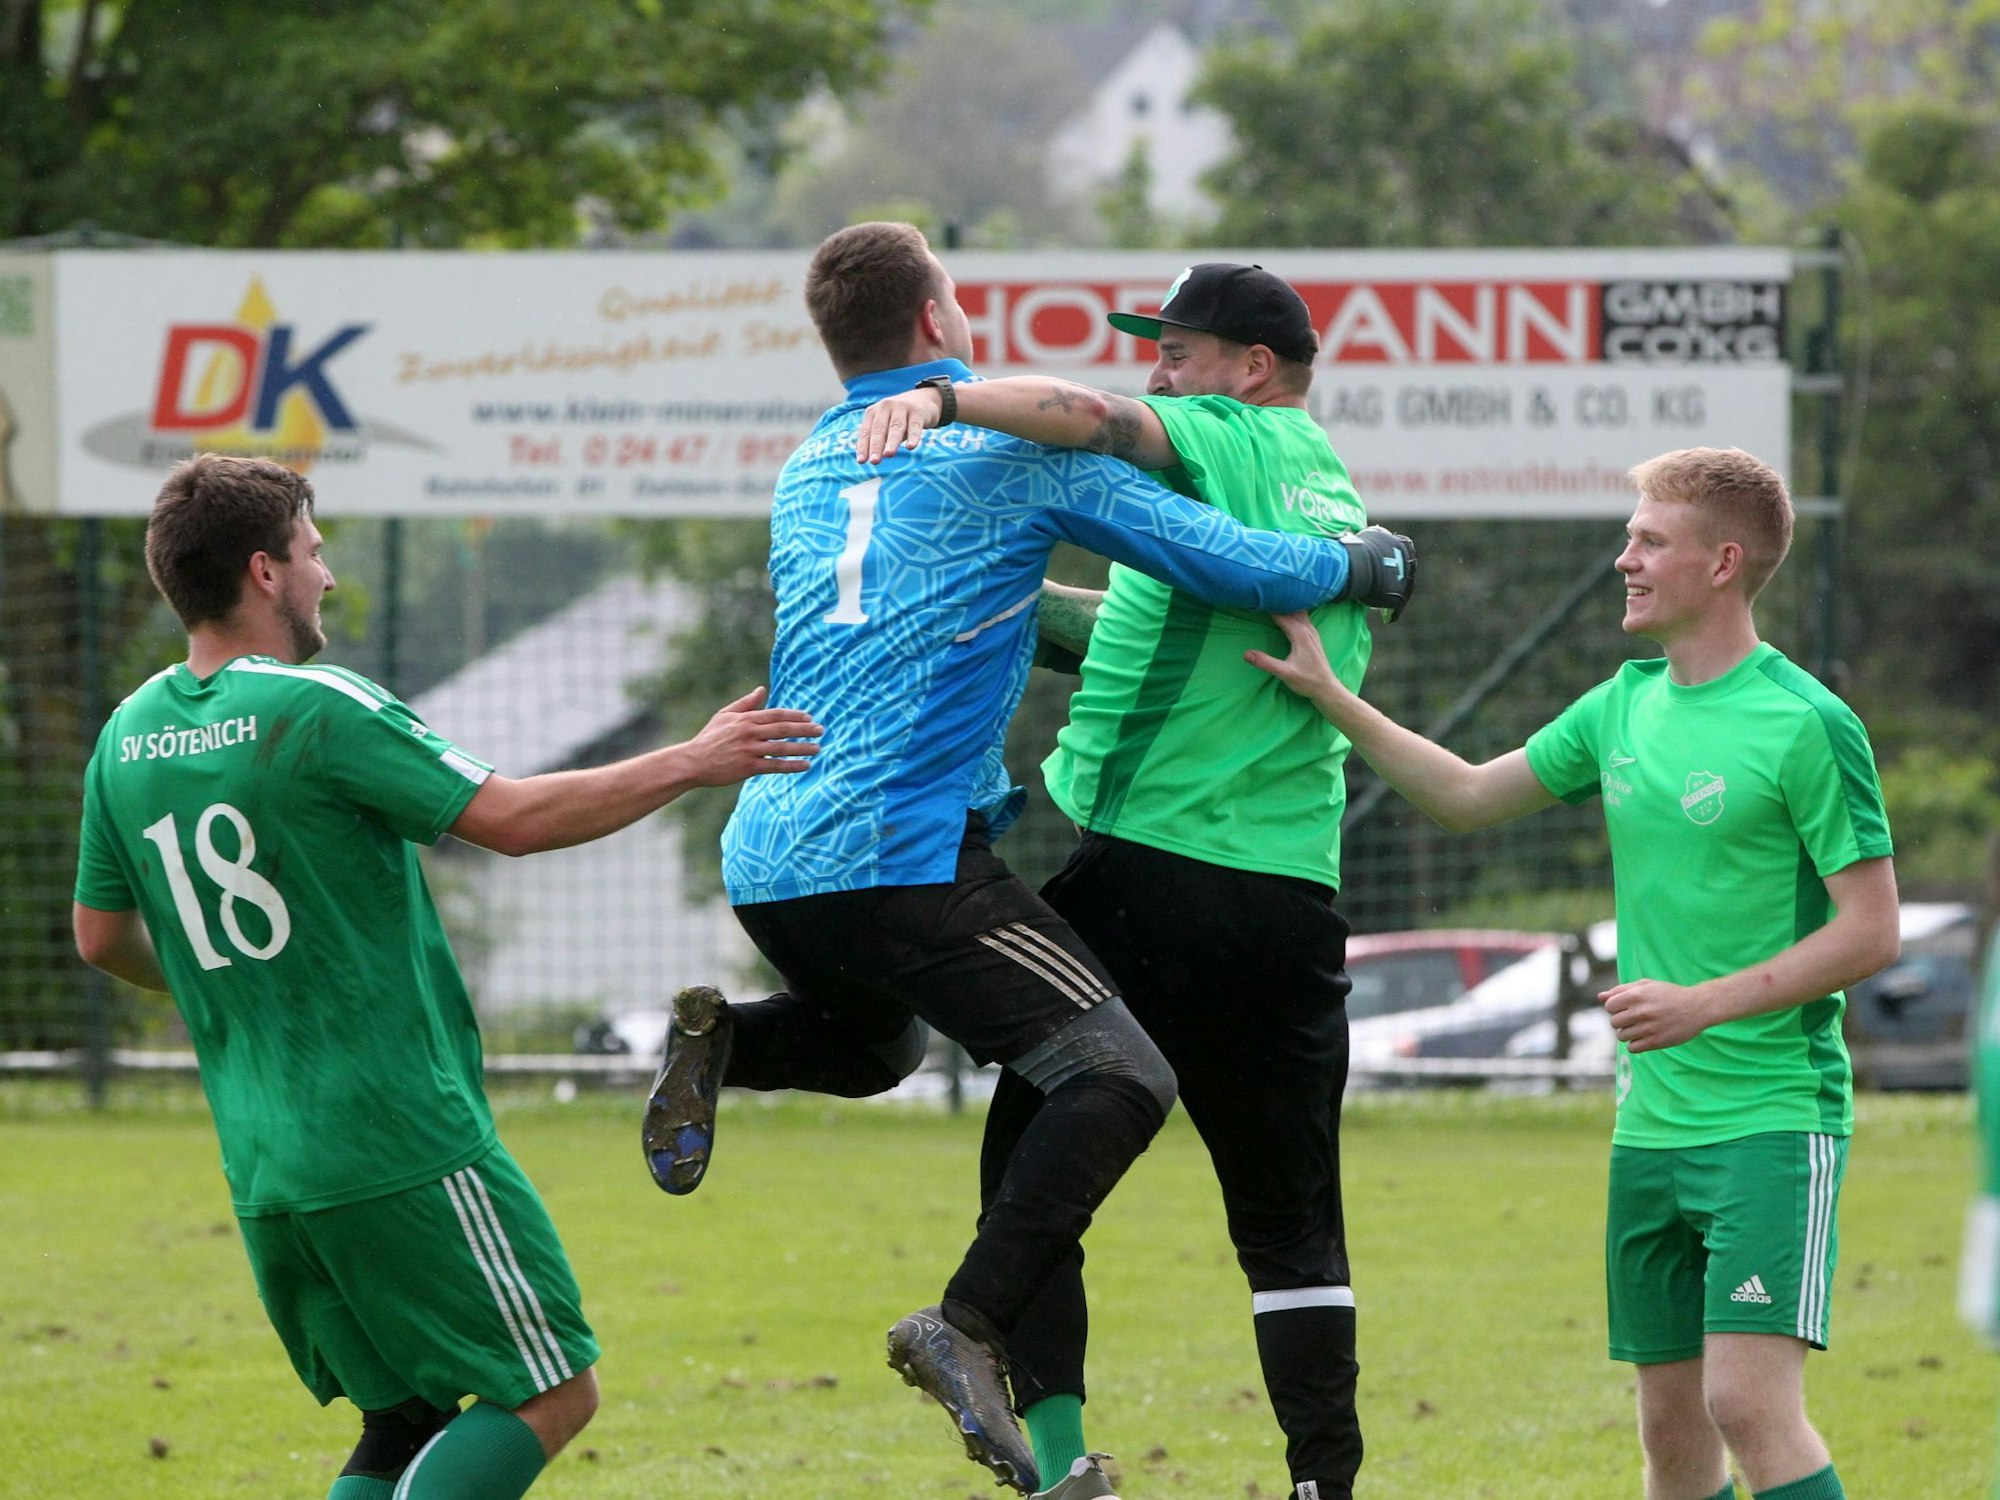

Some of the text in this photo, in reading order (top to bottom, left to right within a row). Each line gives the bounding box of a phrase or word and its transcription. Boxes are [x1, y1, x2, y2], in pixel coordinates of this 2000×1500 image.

[150, 322, 374, 433] DK
[1398, 386, 1511, 427] GMBH
[1528, 386, 1557, 427] &
[1653, 386, 1706, 427] KG
[614, 434, 656, 466] 24
[665, 434, 707, 466] 47
[822, 477, 882, 624] 1
[120, 715, 257, 763] SV SÖTENICH
[142, 803, 291, 971] 18
[1730, 1291, 1772, 1304] adidas
